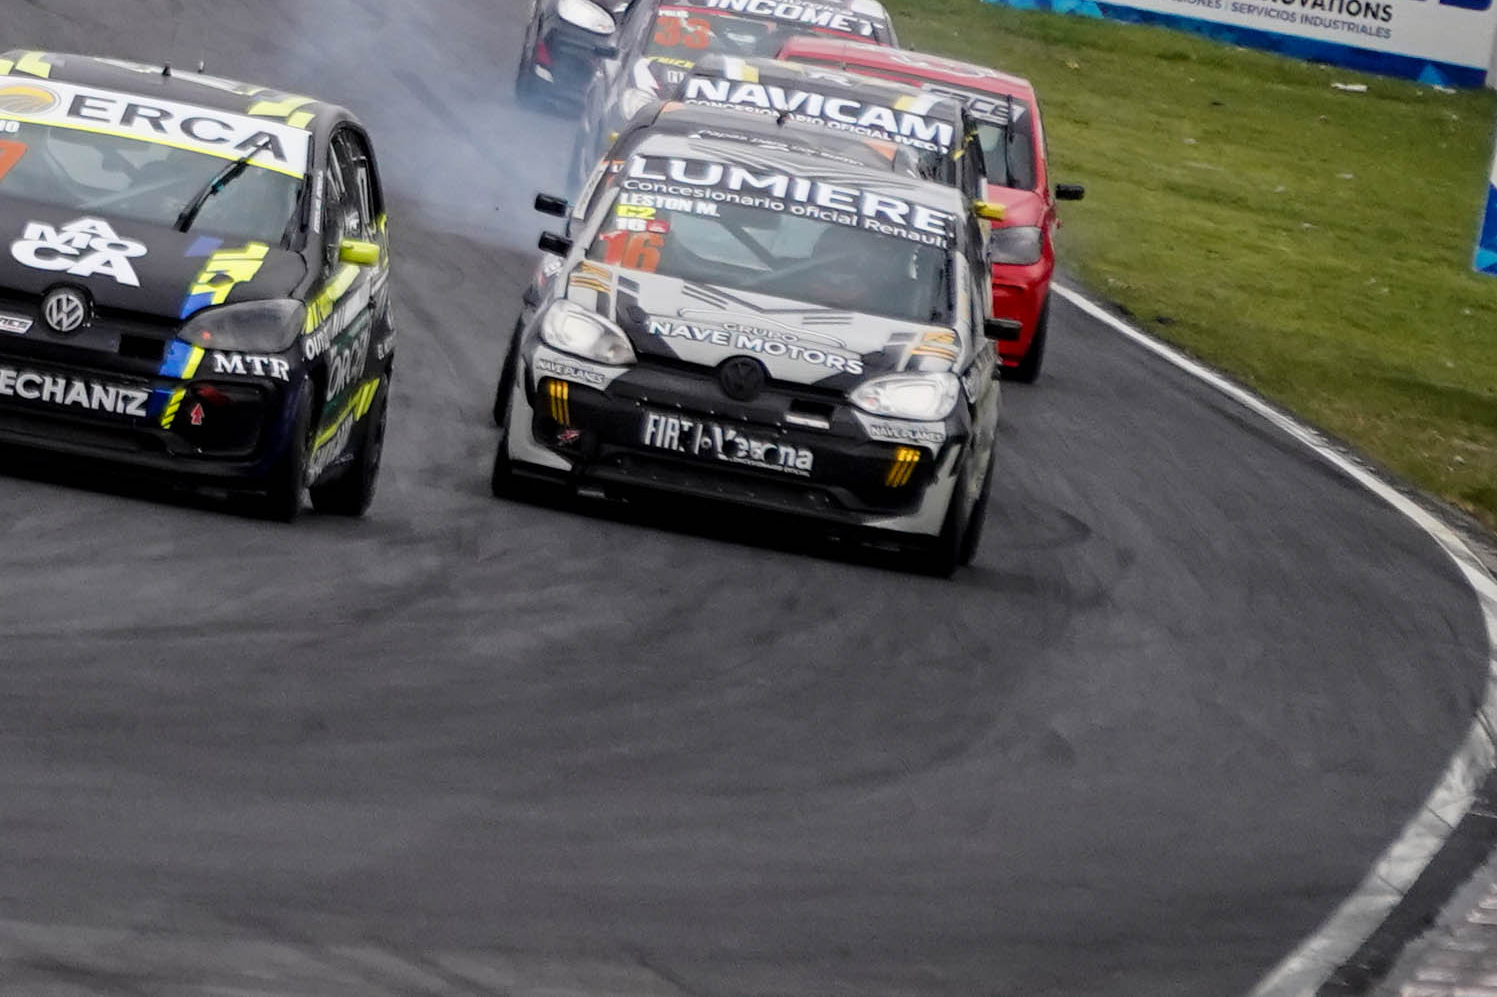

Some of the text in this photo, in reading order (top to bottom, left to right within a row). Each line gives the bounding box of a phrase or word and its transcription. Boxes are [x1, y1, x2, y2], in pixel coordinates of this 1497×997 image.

[654, 15, 711, 50] 33
[1231, 1, 1297, 24] SERVICIOS
[1299, 13, 1392, 40] INDUSTRIALES
[66, 94, 288, 163] ERCA
[685, 77, 954, 147] NAVICAM
[827, 119, 893, 142] OFICIAL
[623, 180, 785, 211] Concesionario
[790, 202, 858, 227] oficial
[629, 154, 956, 238] LUMIERE
[599, 230, 666, 272] 16
[213, 351, 291, 383] MTR
[648, 320, 864, 376] NAVE MOTORS
